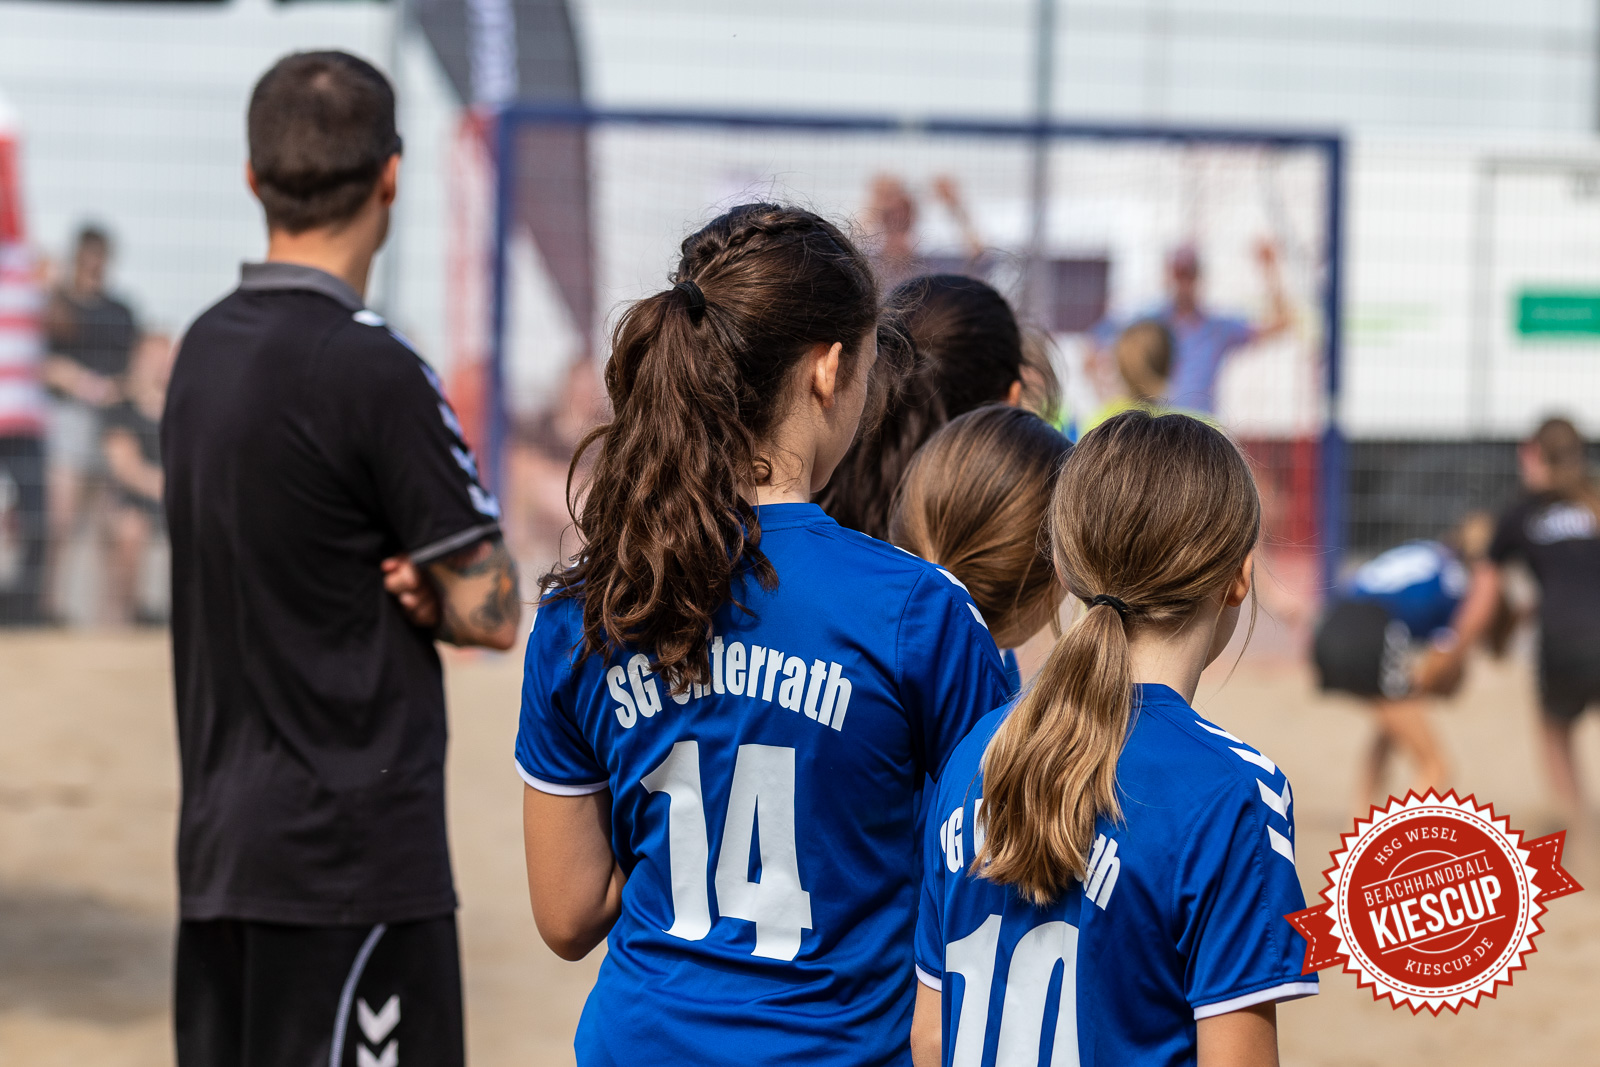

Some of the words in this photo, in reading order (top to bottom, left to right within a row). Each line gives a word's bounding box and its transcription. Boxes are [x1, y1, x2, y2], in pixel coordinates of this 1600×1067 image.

[606, 653, 663, 729] SG
[640, 740, 813, 961] 14
[945, 913, 1080, 1067] 10
